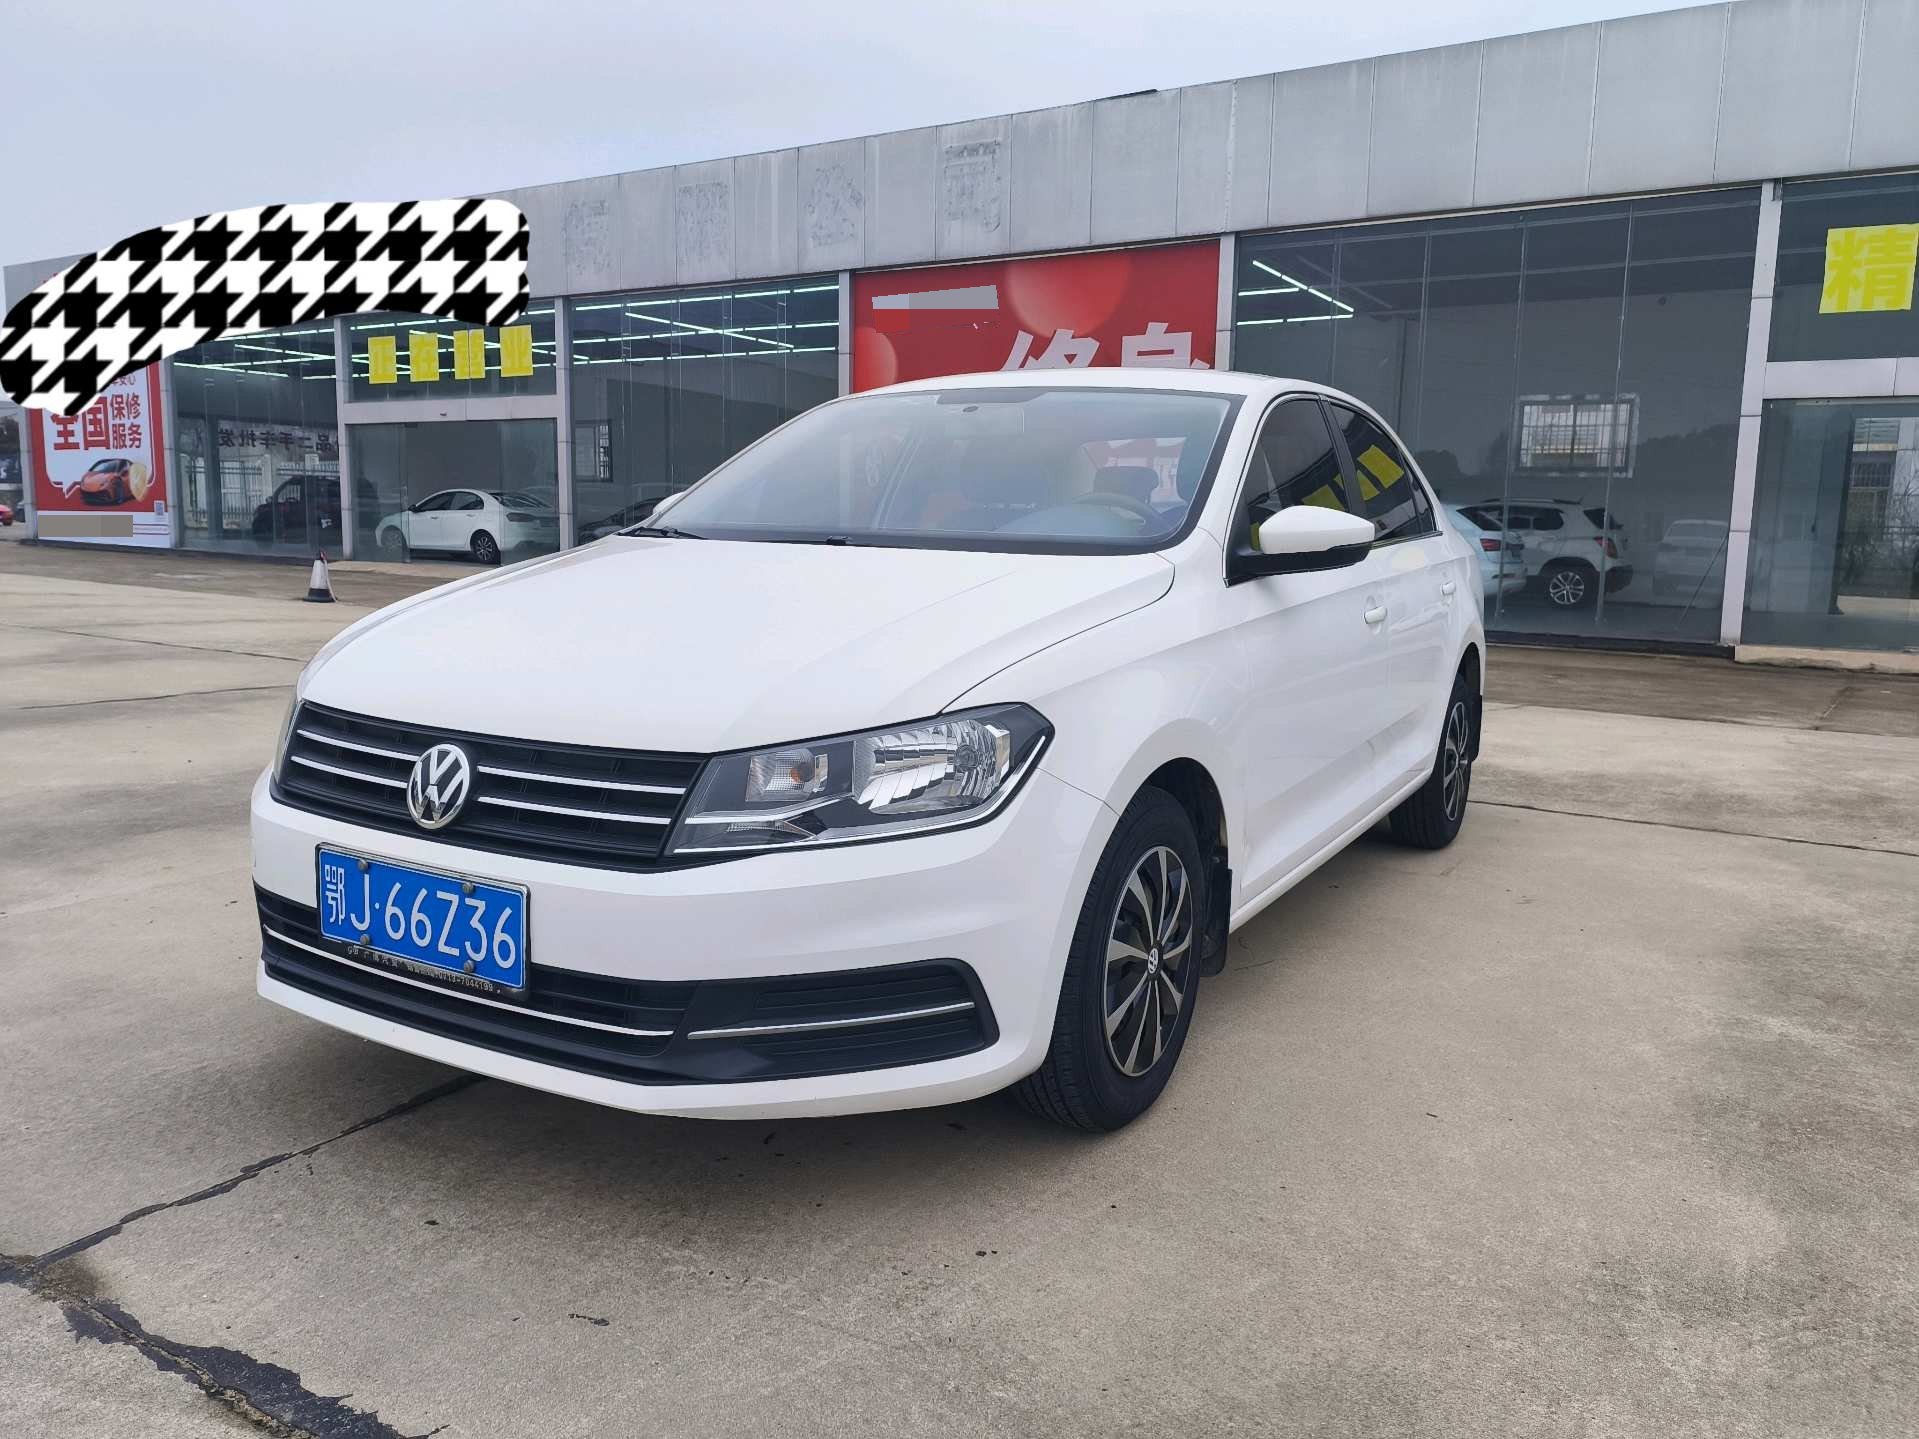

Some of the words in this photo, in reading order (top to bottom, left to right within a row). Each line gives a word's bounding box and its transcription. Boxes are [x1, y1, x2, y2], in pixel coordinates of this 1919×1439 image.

[1824, 227, 1917, 312] 精
[111, 392, 141, 421] 保修
[111, 422, 142, 450] 服务
[324, 864, 516, 969] 鄂J·66Z36
